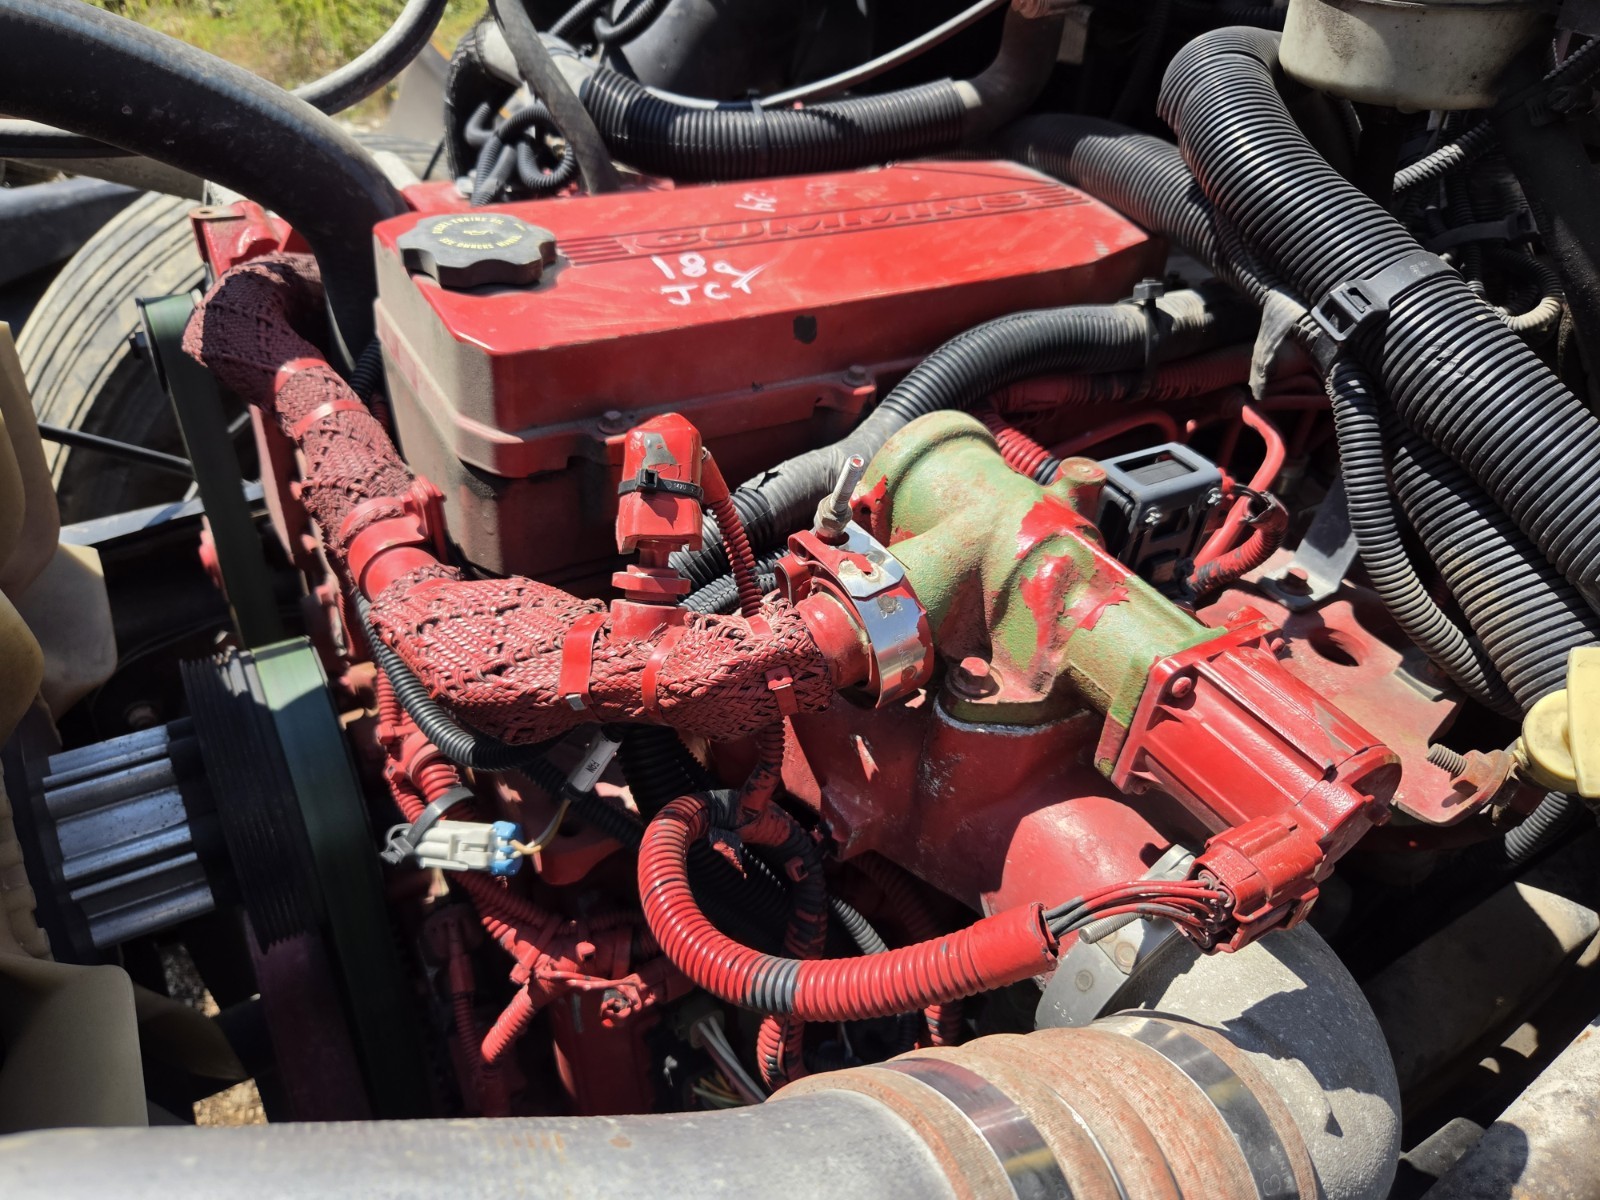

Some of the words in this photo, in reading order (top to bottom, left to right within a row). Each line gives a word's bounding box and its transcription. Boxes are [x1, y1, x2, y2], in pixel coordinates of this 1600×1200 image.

[631, 193, 1031, 249] CUMMINS
[457, 242, 494, 250] OWNERS
[585, 759, 600, 773] FAN
